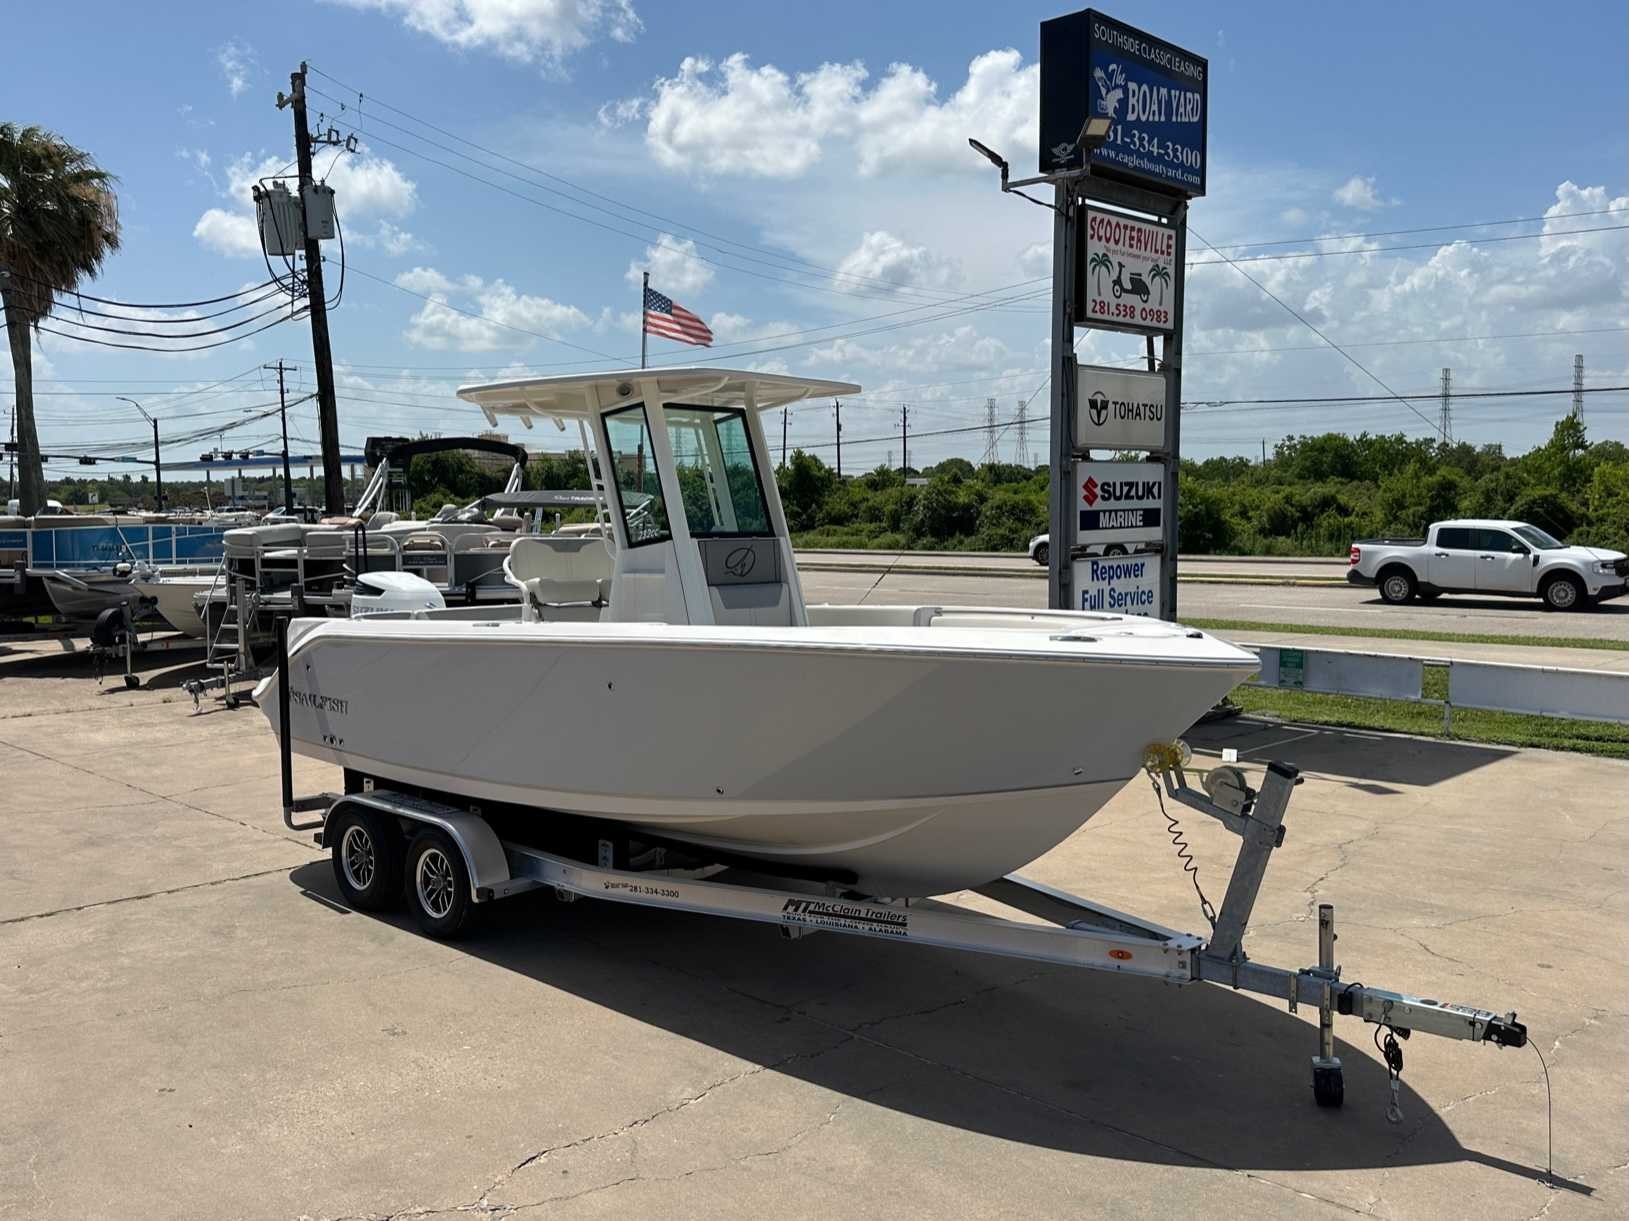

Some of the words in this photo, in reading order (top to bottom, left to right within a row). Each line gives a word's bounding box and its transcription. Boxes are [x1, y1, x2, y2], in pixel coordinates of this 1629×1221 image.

[1094, 23, 1139, 55] SOUTHSIDE
[1141, 43, 1171, 69] CLASSIC
[1171, 58, 1203, 81] LEASING
[1108, 63, 1126, 87] The
[1127, 82, 1168, 122] BOAT
[1171, 90, 1201, 123] YARD
[1090, 216, 1173, 257] SCOOTERVILLE
[1091, 299, 1136, 319] 281.538
[1140, 307, 1169, 324] 0983
[1112, 401, 1163, 421] TOHATSU
[1100, 481, 1162, 501] SUZUKI
[1100, 510, 1144, 529] MARINE
[1091, 561, 1145, 586] Repower
[1081, 588, 1104, 611] Full
[1108, 586, 1154, 608] Service
[629, 884, 680, 898] 281-334-3300
[814, 902, 861, 916] McClain
[865, 908, 908, 922] Trailers
[782, 914, 807, 923] TEXAS
[815, 918, 858, 930] LOUISIANA
[868, 926, 908, 937] ALABAMA
